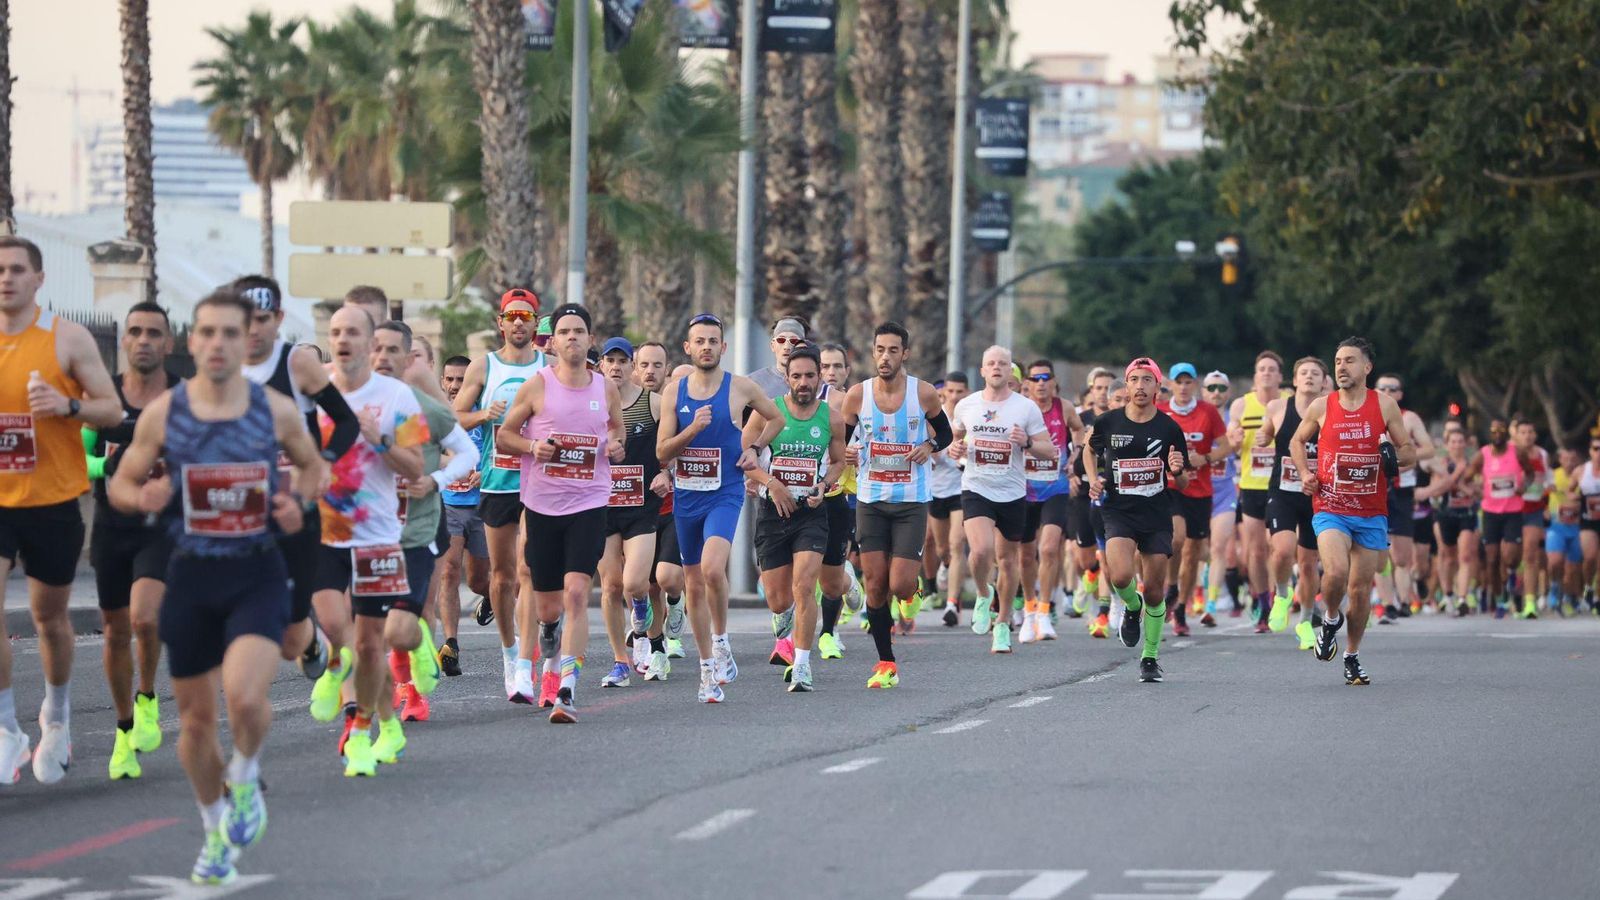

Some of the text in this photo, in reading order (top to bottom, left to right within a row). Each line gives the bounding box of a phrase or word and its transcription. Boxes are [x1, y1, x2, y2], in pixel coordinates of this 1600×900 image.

[973, 425, 1008, 434] SAYSKY
[562, 436, 597, 445] GENERALI
[780, 440, 822, 453] mijas
[880, 444, 910, 452] GENERALI
[560, 449, 584, 460] 2402
[980, 452, 1004, 460] 15700
[783, 459, 813, 467] GENERALI
[879, 457, 900, 466] 8002
[682, 462, 710, 473] 12893
[780, 472, 807, 481] 10882
[1128, 472, 1155, 481] 12200
[1348, 468, 1369, 477] 7368
[611, 480, 632, 489] 2485
